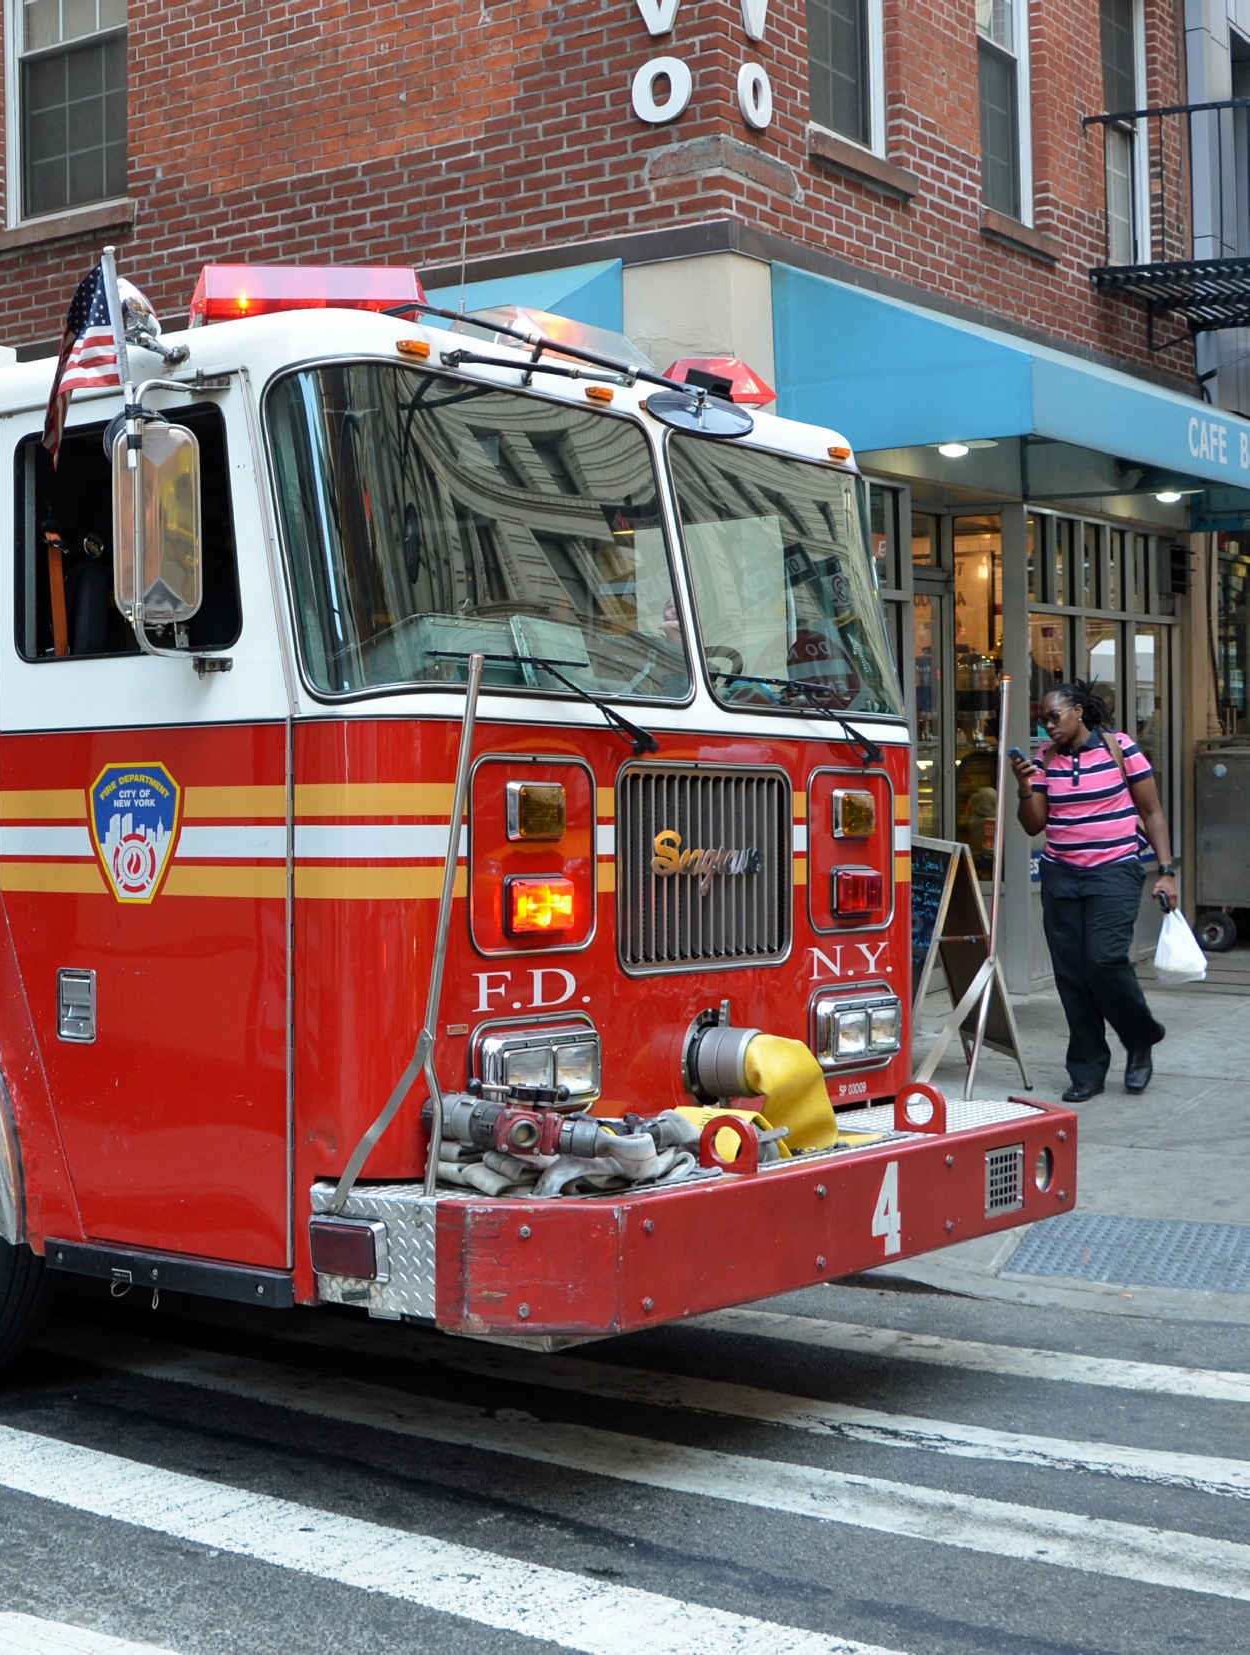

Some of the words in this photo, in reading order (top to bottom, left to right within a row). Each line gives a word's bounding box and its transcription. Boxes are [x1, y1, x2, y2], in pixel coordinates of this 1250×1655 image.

[1188, 416, 1227, 464] CAFE
[100, 781, 117, 800] FIRE
[119, 774, 170, 798] DEPARTMENT
[114, 799, 131, 807] NEW
[134, 799, 156, 807] YORK
[118, 790, 136, 799] CITY
[139, 789, 151, 798] OF
[807, 942, 893, 980] N.Y.
[471, 968, 591, 1013] F.D.
[839, 1084, 848, 1097] SP
[871, 1160, 901, 1256] 4
